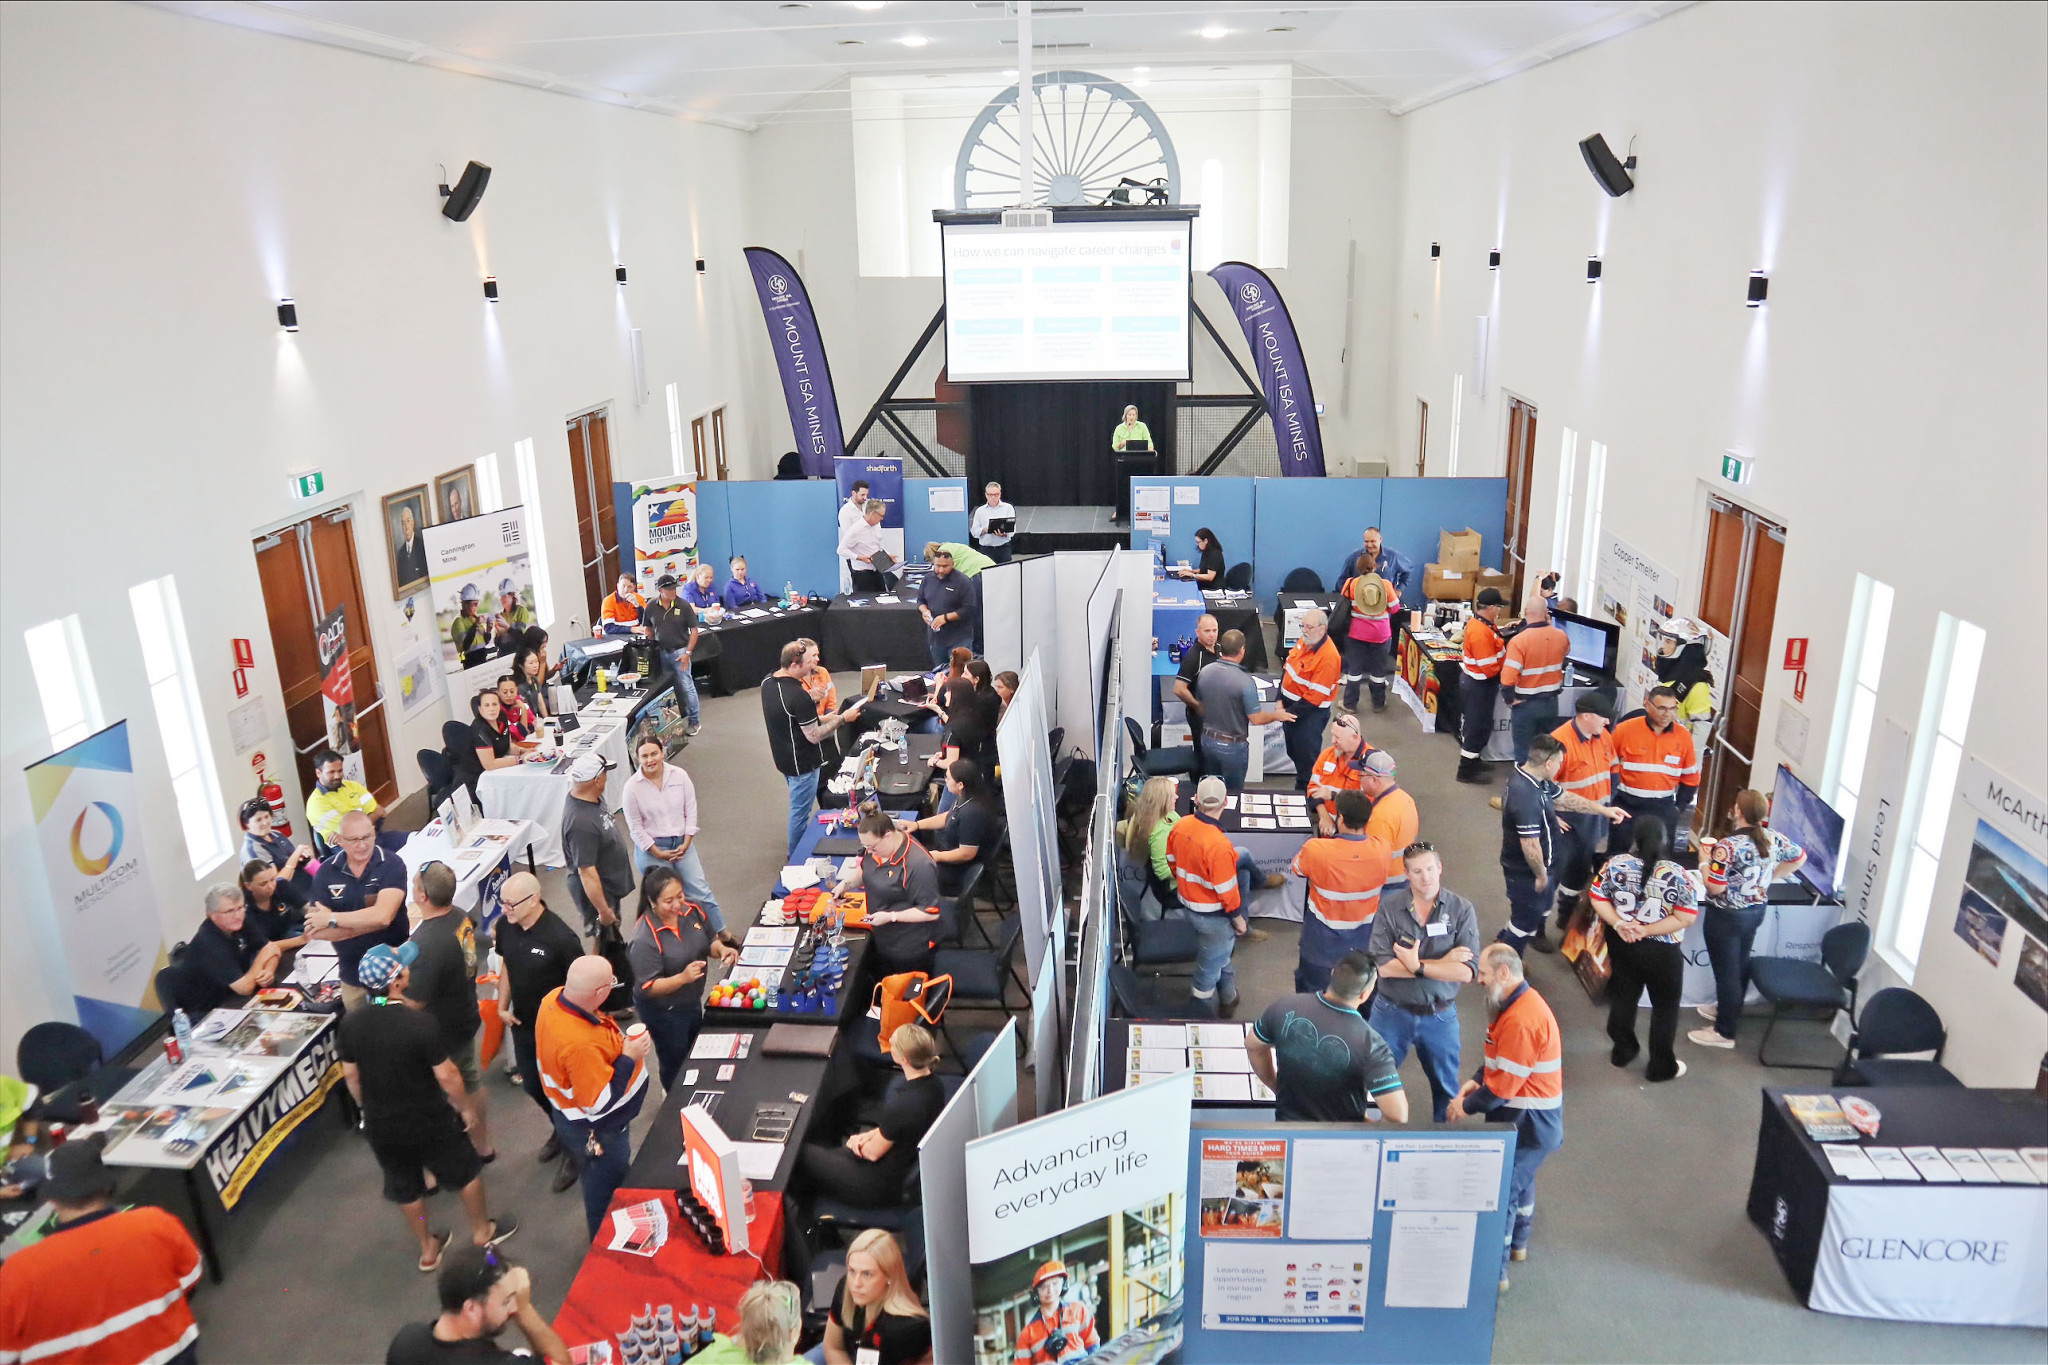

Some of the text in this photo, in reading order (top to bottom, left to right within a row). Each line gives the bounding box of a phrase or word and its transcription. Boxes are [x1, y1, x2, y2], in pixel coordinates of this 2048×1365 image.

[953, 242, 1167, 260] How we can navigate career changes
[782, 315, 809, 375] MOUNT
[798, 378, 814, 404] ISA
[1258, 322, 1289, 381] MOUNT
[1278, 384, 1294, 411] ISA
[1286, 413, 1309, 462] MINES
[805, 406, 826, 455] MINES
[866, 464, 898, 473] shadforth
[648, 522, 691, 539] MOUNT ISA
[649, 532, 692, 545] CITY COUNCIL
[440, 542, 475, 556] Cannington
[442, 555, 457, 565] Mine
[1613, 543, 1661, 583] Copper Smelter
[1870, 797, 1891, 857] Lead
[73, 858, 138, 905] MULTICOM
[206, 1030, 340, 1192] HEAVYMECH
[993, 1129, 1127, 1190] Advancing
[994, 1152, 1148, 1219] everyday life
[1840, 1237, 2009, 1266] GLENCORE
[1213, 1276, 1267, 1284] opportunities
[1240, 1267, 1265, 1275] about
[1226, 1293, 1252, 1302] region
[1242, 1284, 1262, 1292] local
